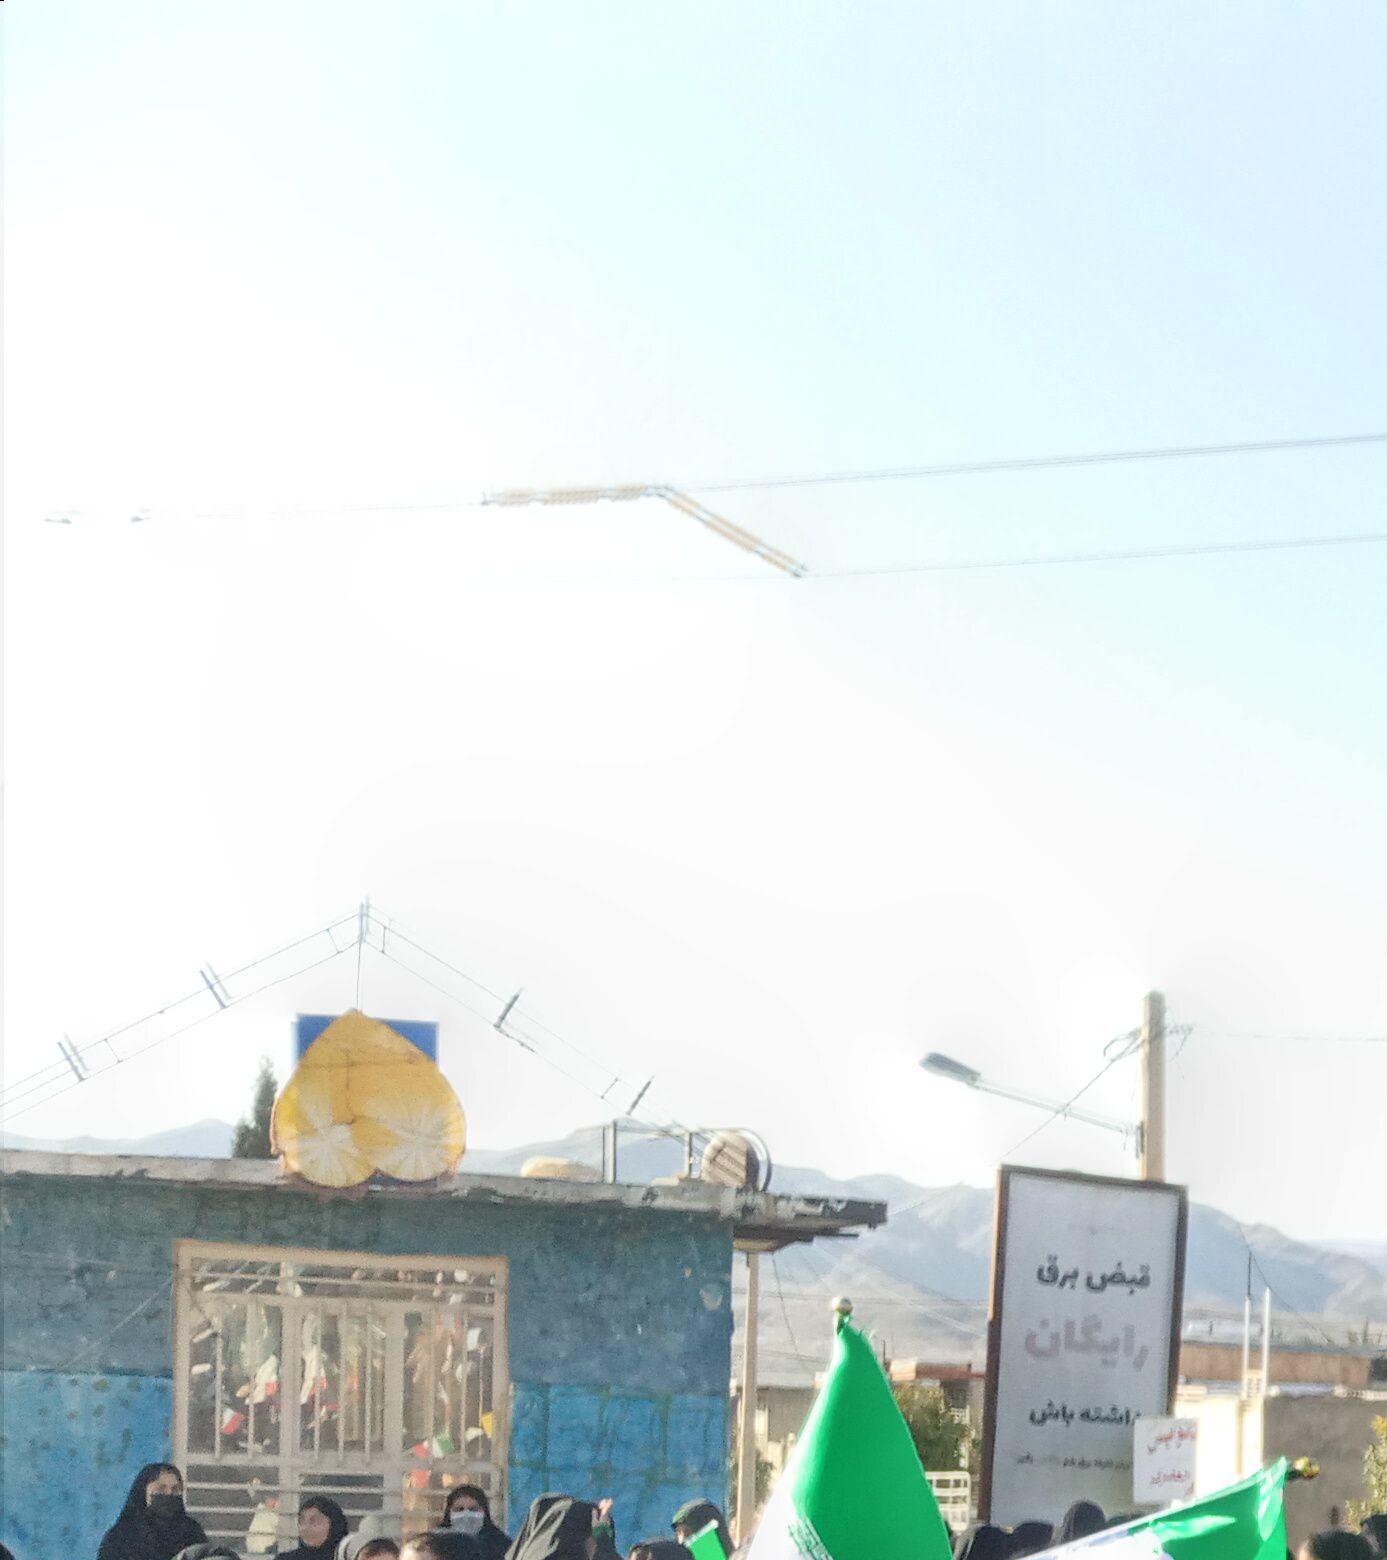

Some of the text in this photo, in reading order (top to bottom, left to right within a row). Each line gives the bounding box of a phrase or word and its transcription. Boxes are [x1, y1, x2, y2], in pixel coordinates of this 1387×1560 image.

[1036, 1254, 1151, 1295] قبض برق
[1025, 1313, 1149, 1372] رایگان
[1028, 1399, 1075, 1428] باش
